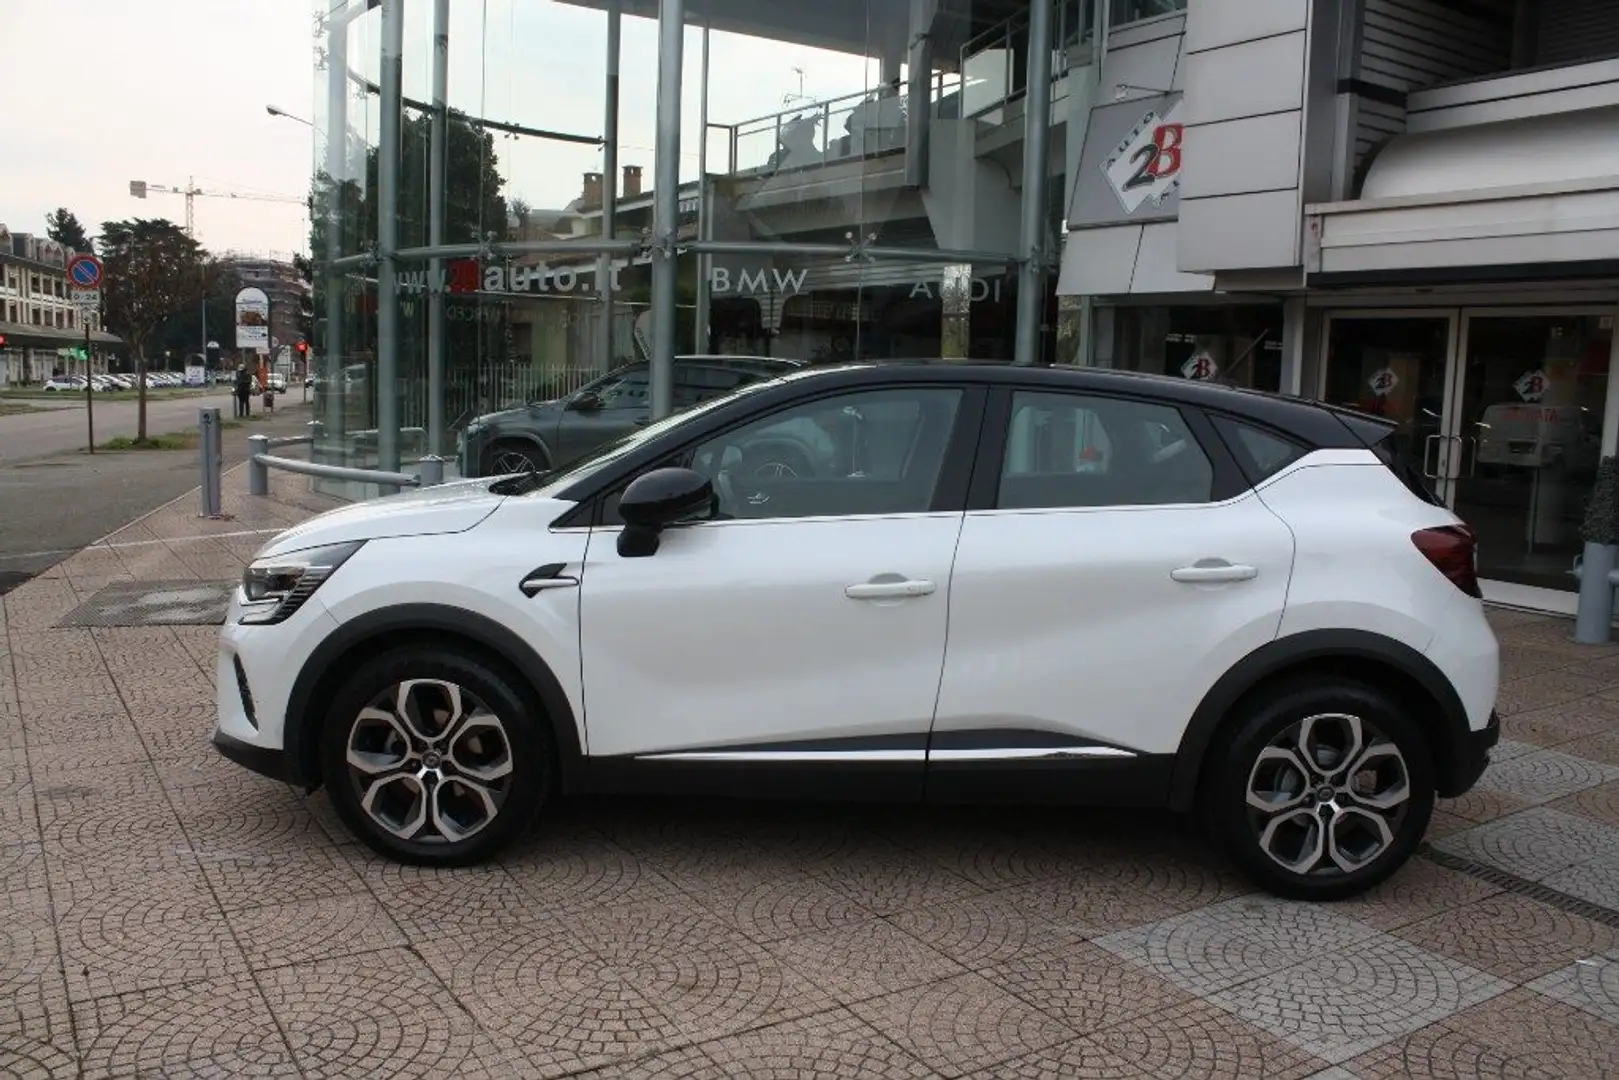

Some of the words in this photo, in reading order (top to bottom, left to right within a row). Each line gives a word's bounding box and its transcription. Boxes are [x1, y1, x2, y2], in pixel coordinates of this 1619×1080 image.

[1122, 123, 1184, 192] 2B
[711, 267, 808, 293] BMW
[909, 277, 1001, 303] ADI
